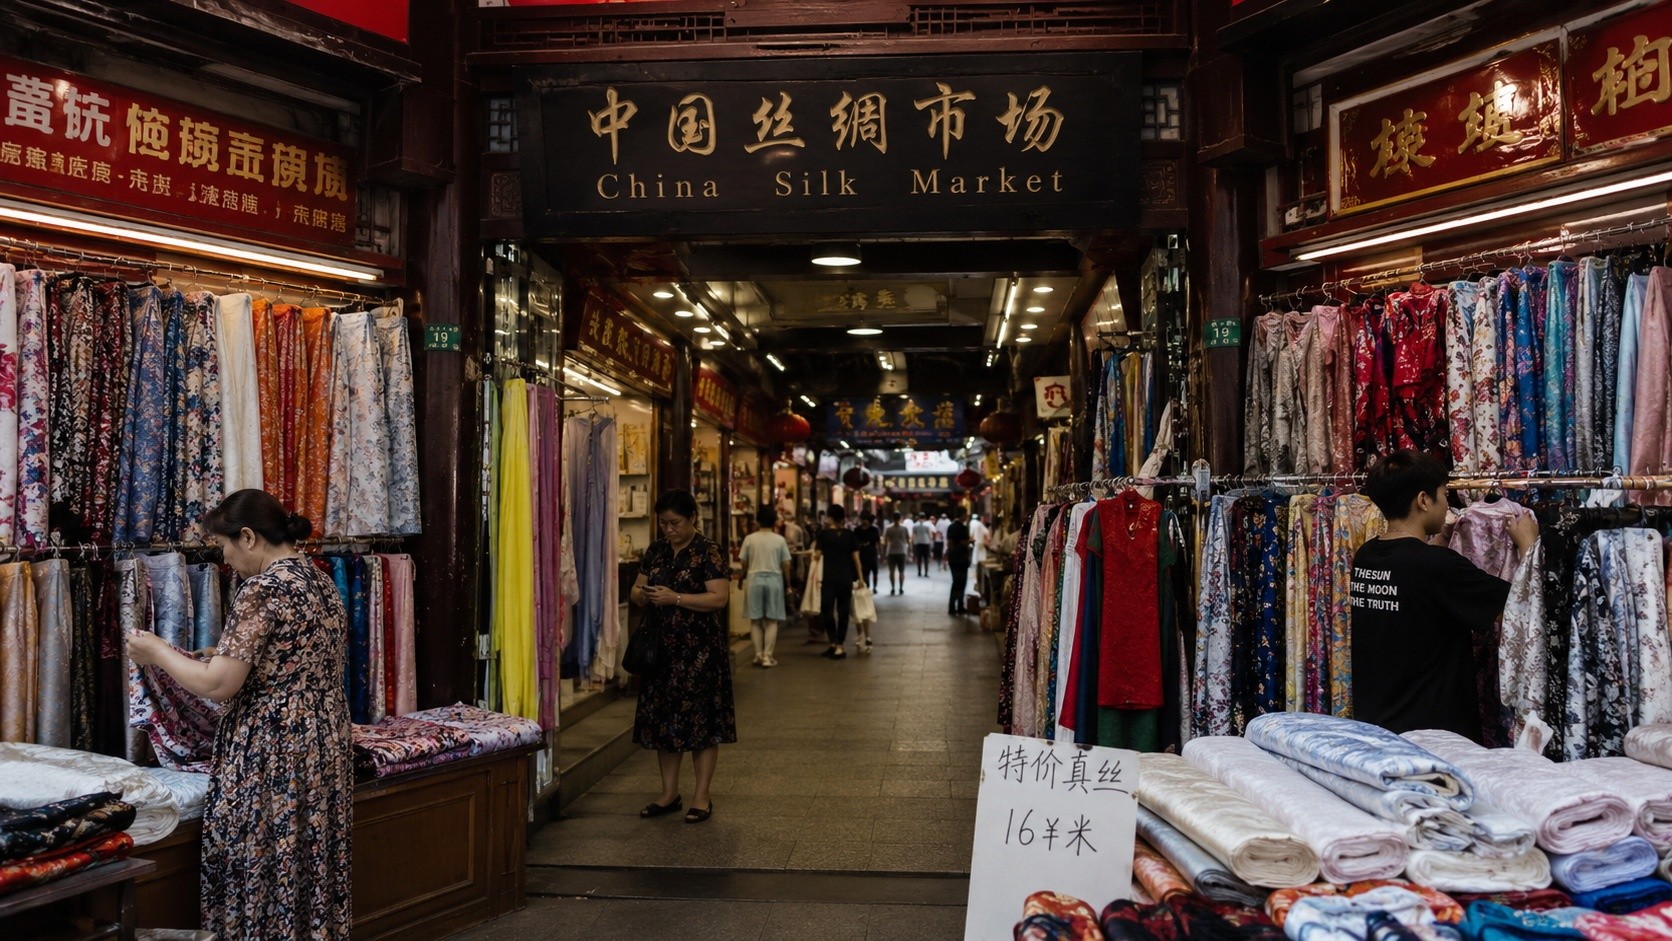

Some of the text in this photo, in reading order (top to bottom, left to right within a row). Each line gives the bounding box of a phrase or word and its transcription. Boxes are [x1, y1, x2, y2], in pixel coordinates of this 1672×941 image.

[588, 82, 1064, 165] 中国丝绸市场
[597, 167, 1065, 200] China Silk Market
[433, 332, 448, 343] 19
[1214, 327, 1229, 338] 19
[1367, 584, 1398, 596] MOON
[1366, 598, 1399, 611] TRUTH
[998, 744, 1129, 794] 特价真丝
[1006, 808, 1098, 857] 16¥米
